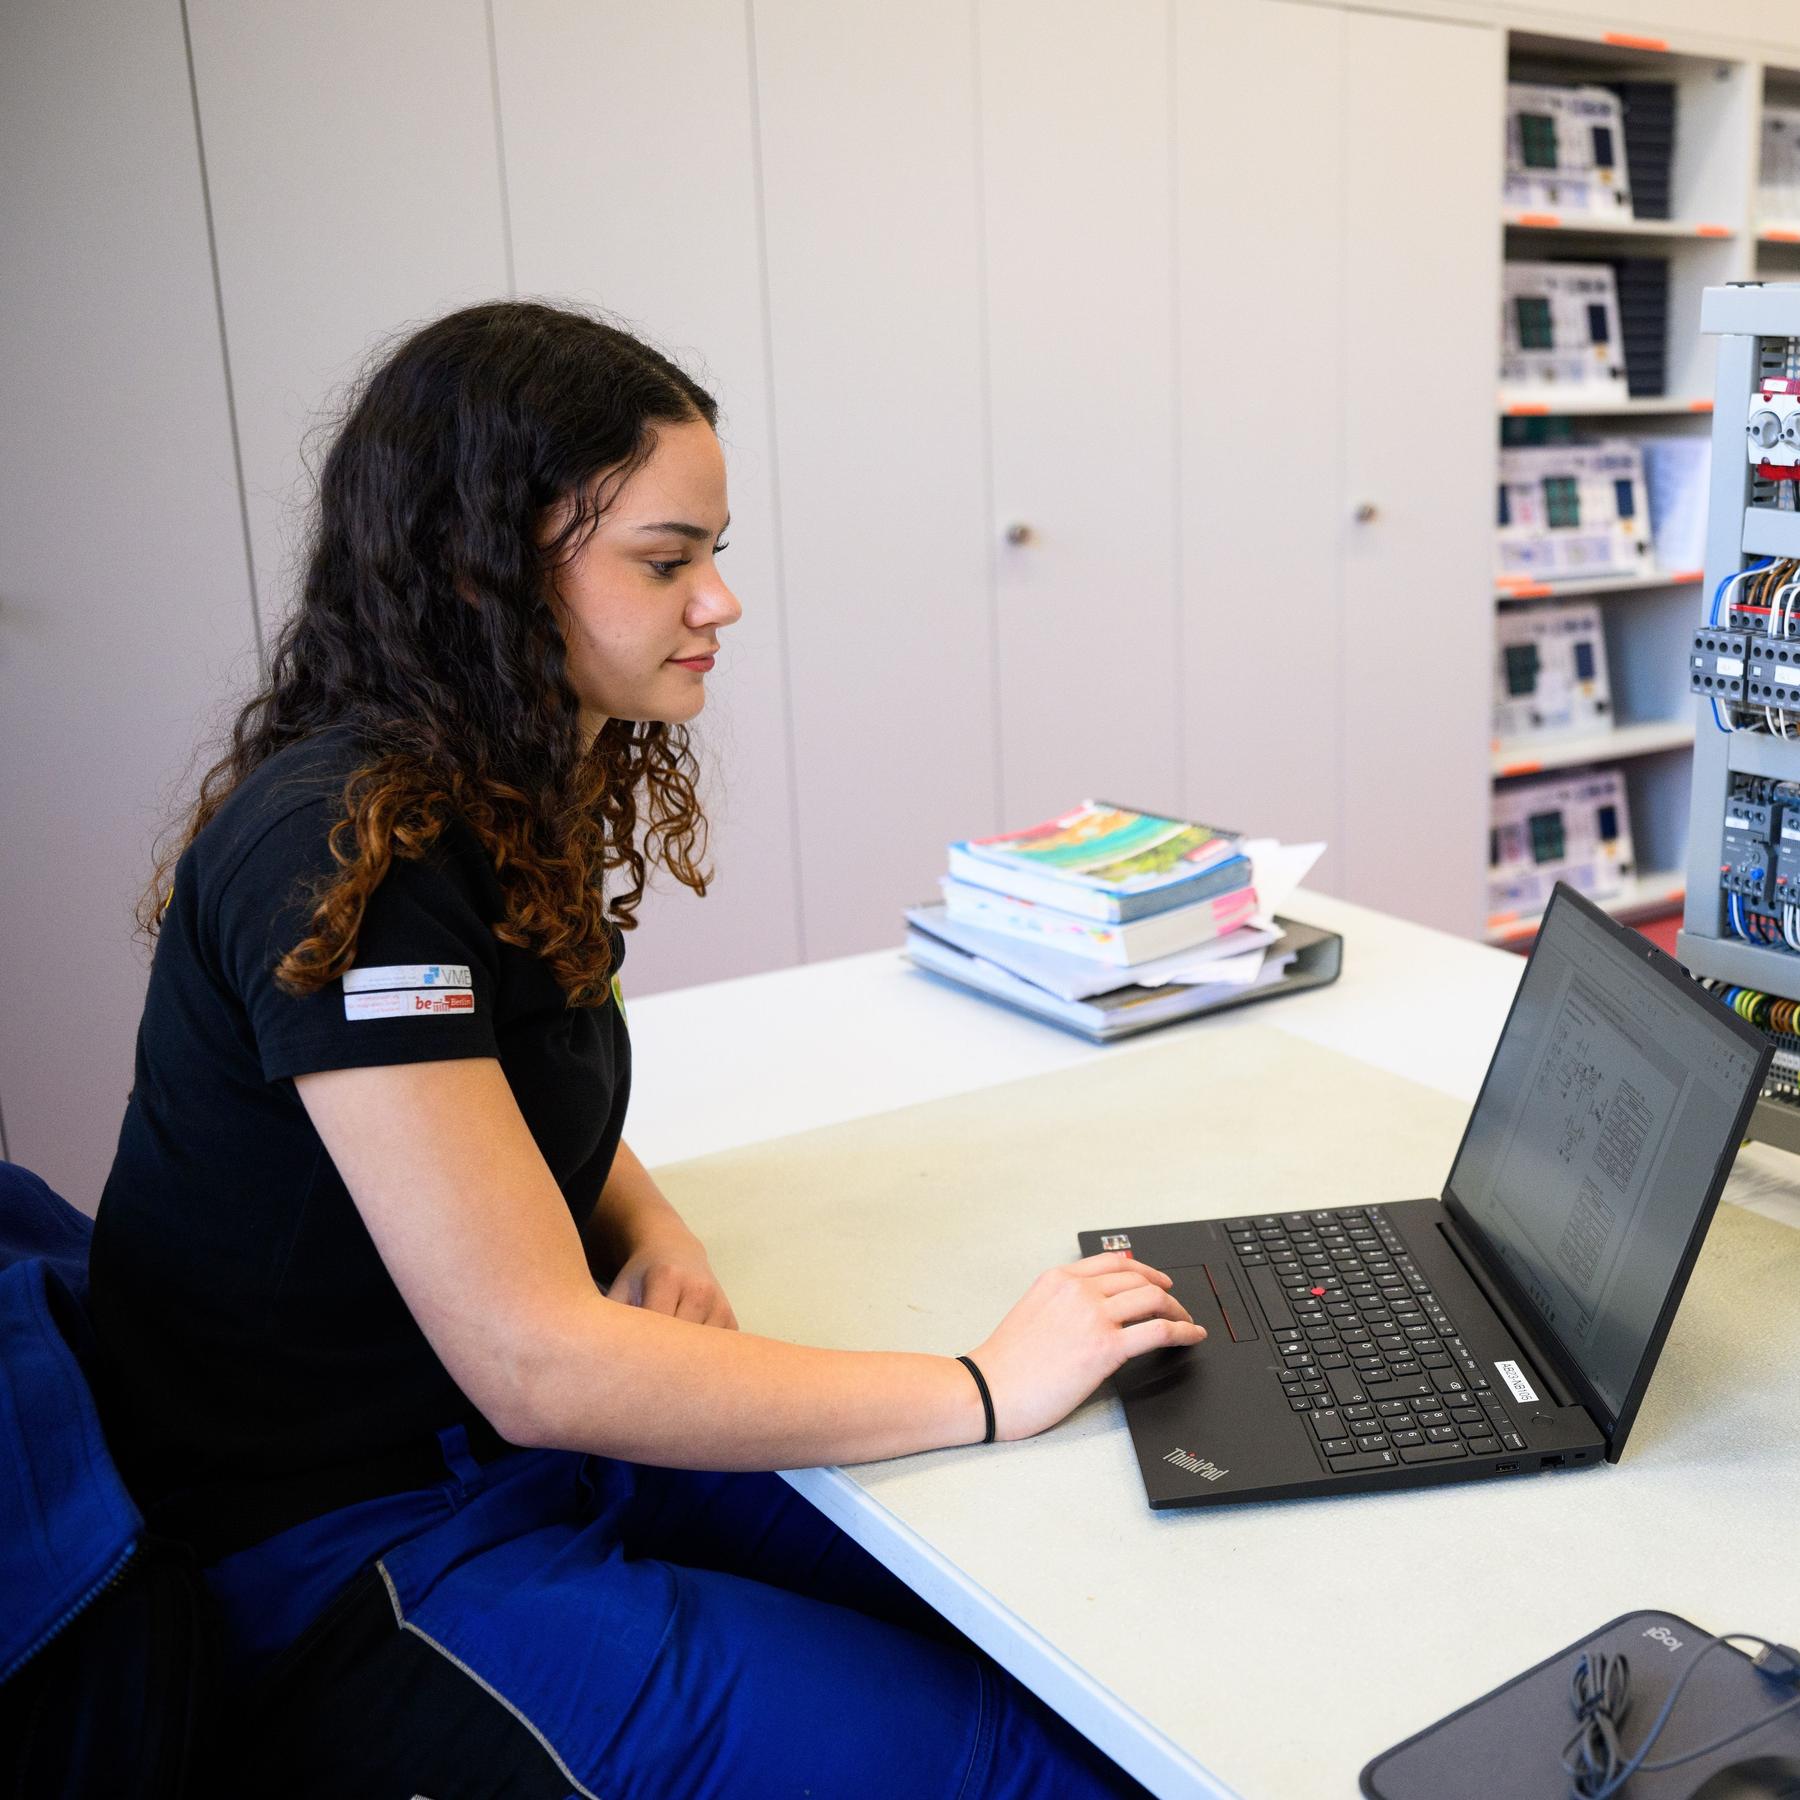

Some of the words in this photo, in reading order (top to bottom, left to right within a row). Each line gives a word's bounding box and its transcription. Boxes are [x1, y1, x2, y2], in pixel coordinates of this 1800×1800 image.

[415, 995, 432, 1010] be
[1162, 1447, 1230, 1481] ThinkPad
[1641, 1626, 1683, 1652] logi
